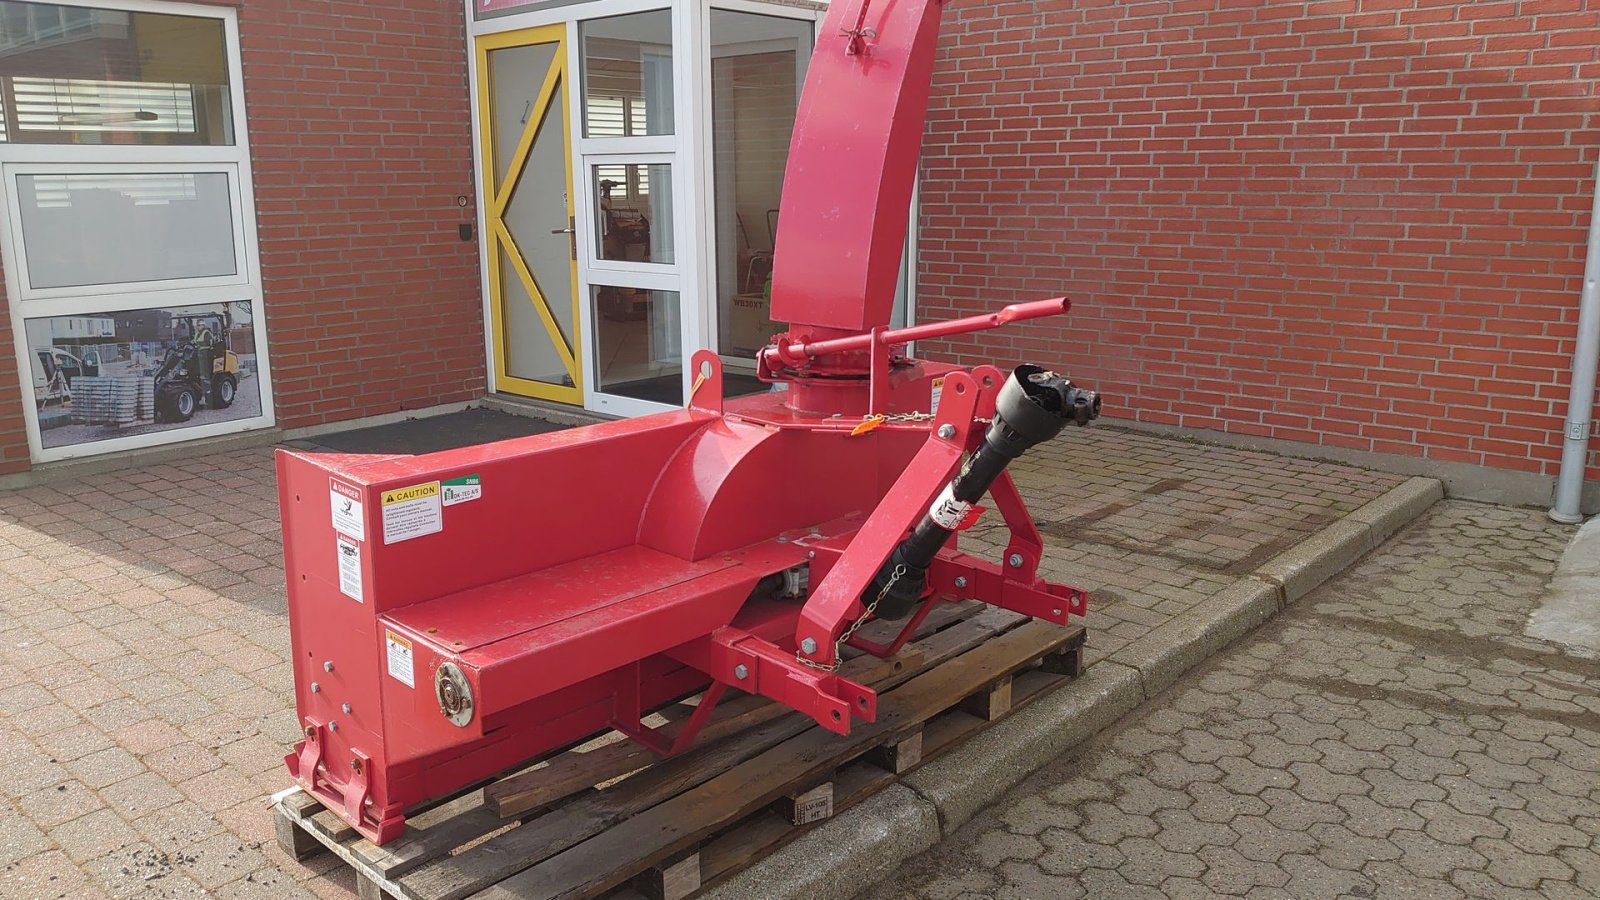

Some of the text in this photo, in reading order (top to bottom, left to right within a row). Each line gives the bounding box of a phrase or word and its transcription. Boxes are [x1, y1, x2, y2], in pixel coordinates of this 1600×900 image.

[338, 485, 359, 499] DANGER
[396, 486, 435, 500] CAUTION
[811, 810, 820, 818] HT
